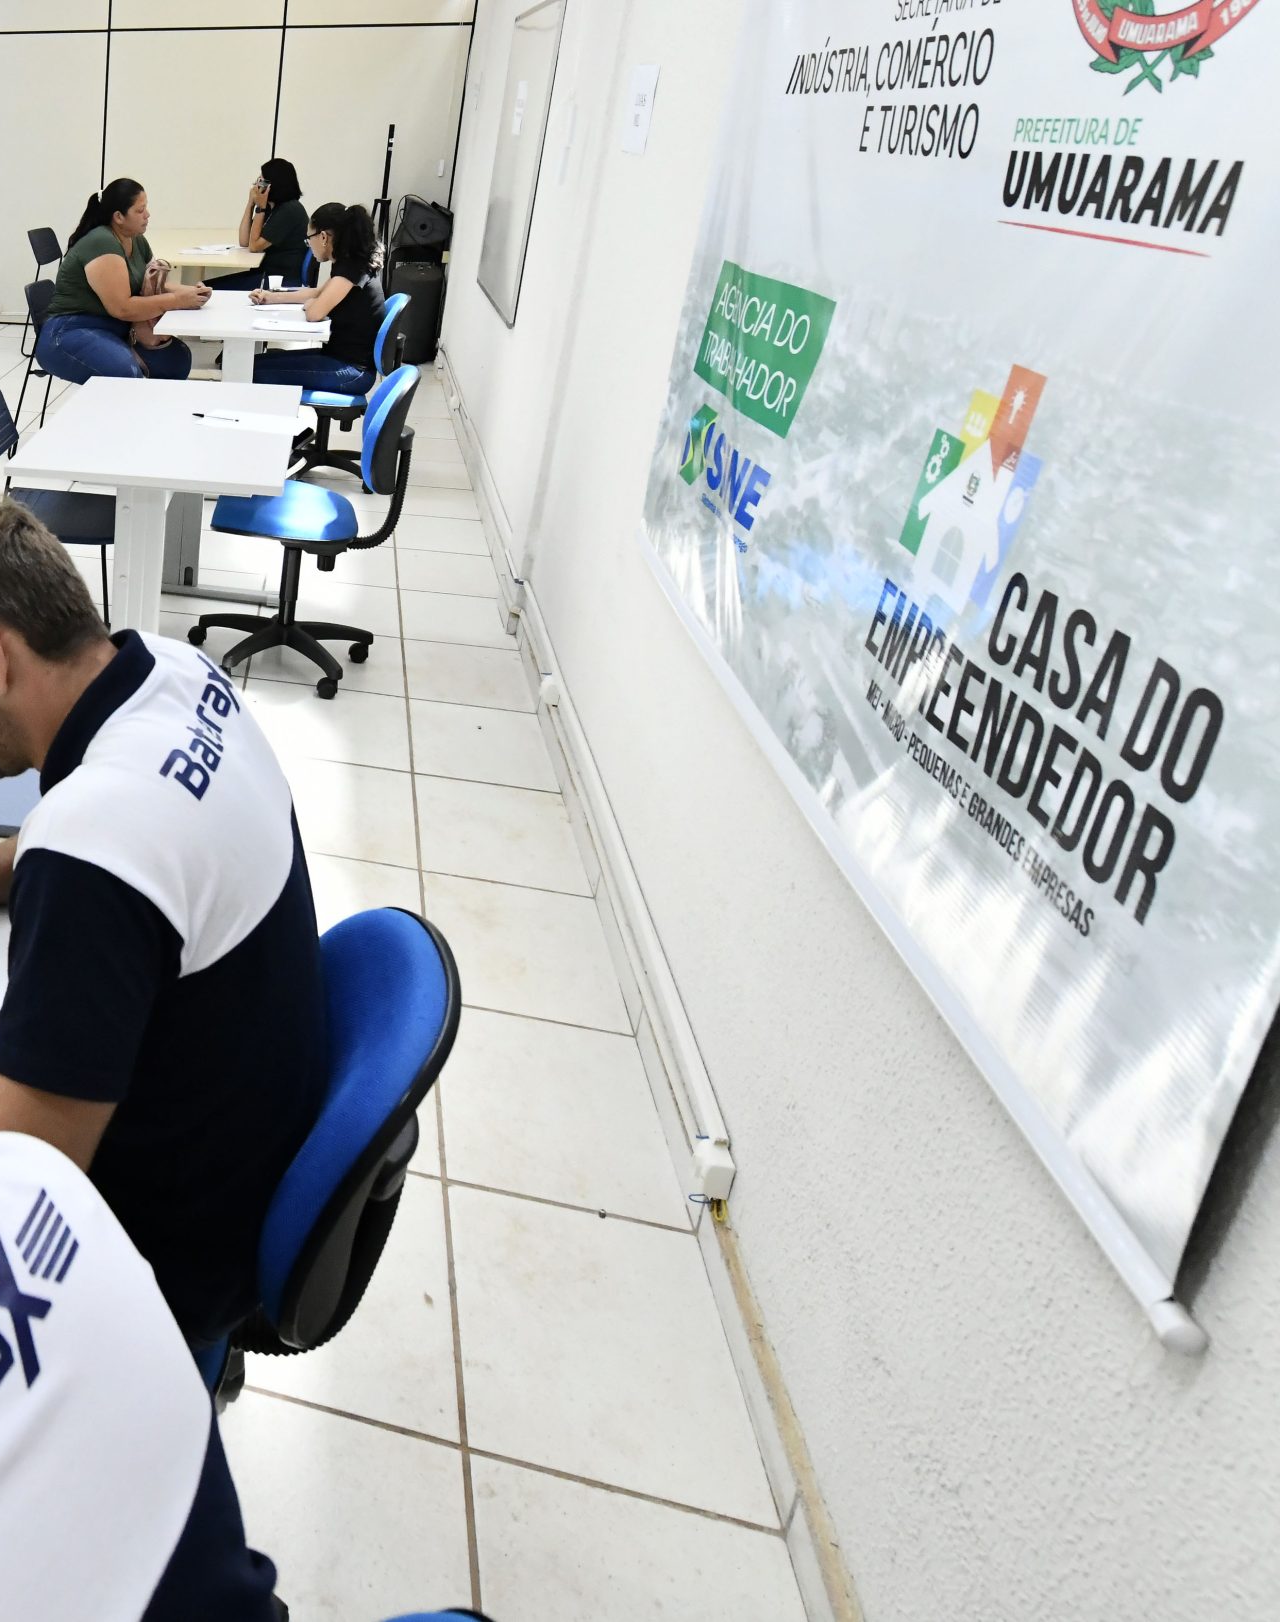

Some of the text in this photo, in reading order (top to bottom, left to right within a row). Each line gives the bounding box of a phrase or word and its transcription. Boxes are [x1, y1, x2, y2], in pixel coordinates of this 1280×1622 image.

[785, 17, 995, 98] INDÚSTRIA, COMÉRCIO
[1118, 11, 1199, 44] UMUARAMA
[859, 103, 980, 159] E TURISMO
[1013, 117, 1143, 146] PREFEITURA DE
[1002, 150, 1245, 237] UMUARAMA
[773, 308, 811, 355] DO
[988, 572, 1224, 804] CASA DO
[864, 577, 1176, 926] EMPREENDEDOR
[866, 680, 882, 710] MEI
[907, 733, 962, 798] PEQUENAS
[959, 783, 971, 809] E
[969, 791, 1027, 862] GRANDES
[1022, 846, 1095, 937] EMPRESAS
